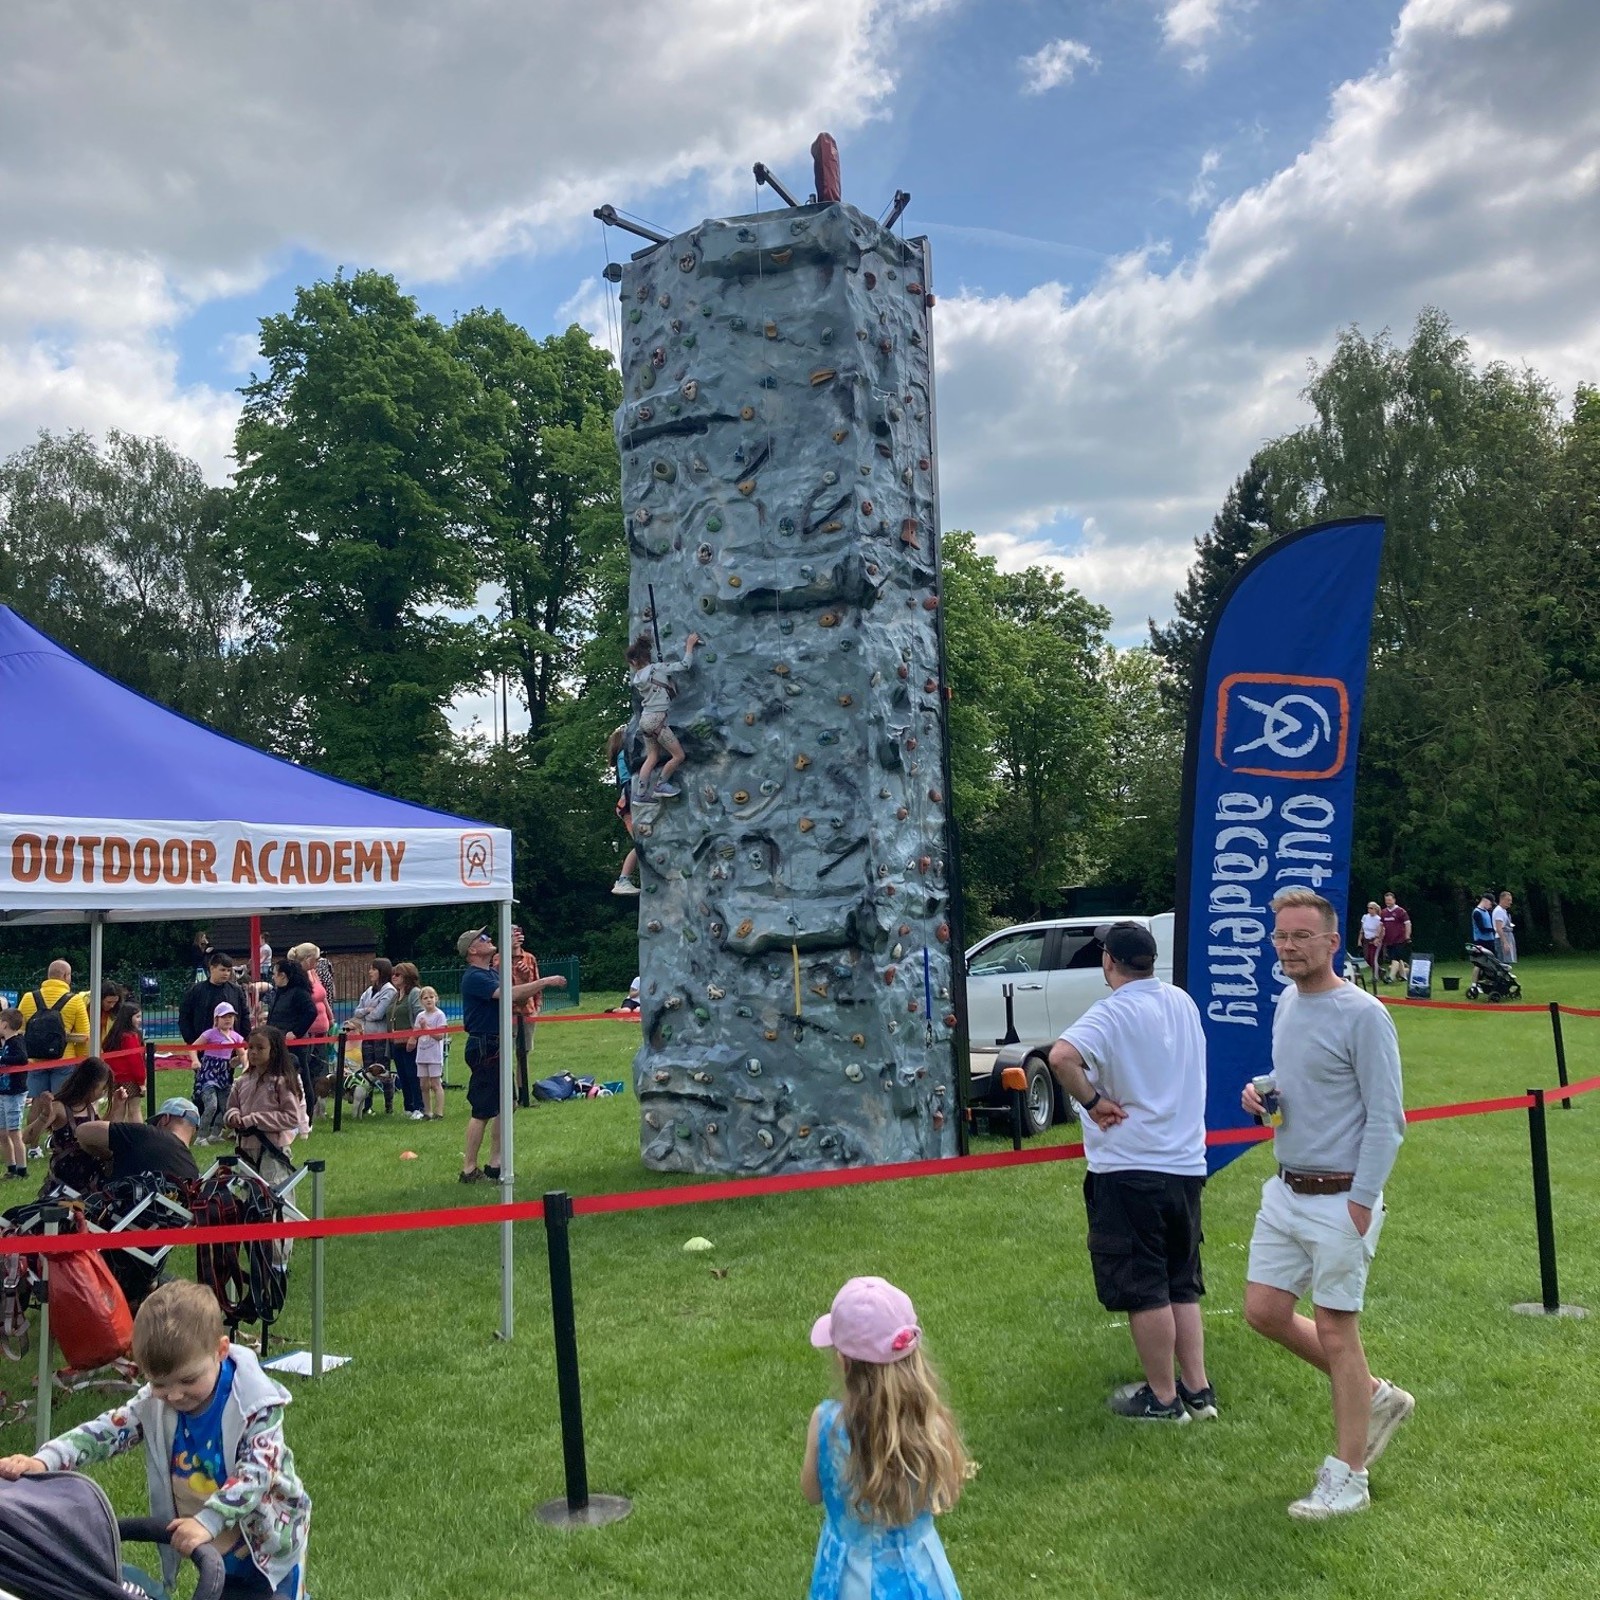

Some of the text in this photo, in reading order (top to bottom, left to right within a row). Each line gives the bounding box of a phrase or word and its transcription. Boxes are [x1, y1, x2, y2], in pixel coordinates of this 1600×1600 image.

[11, 833, 406, 884] OUTDOOR ACADEMY
[1207, 792, 1273, 1027] academy
